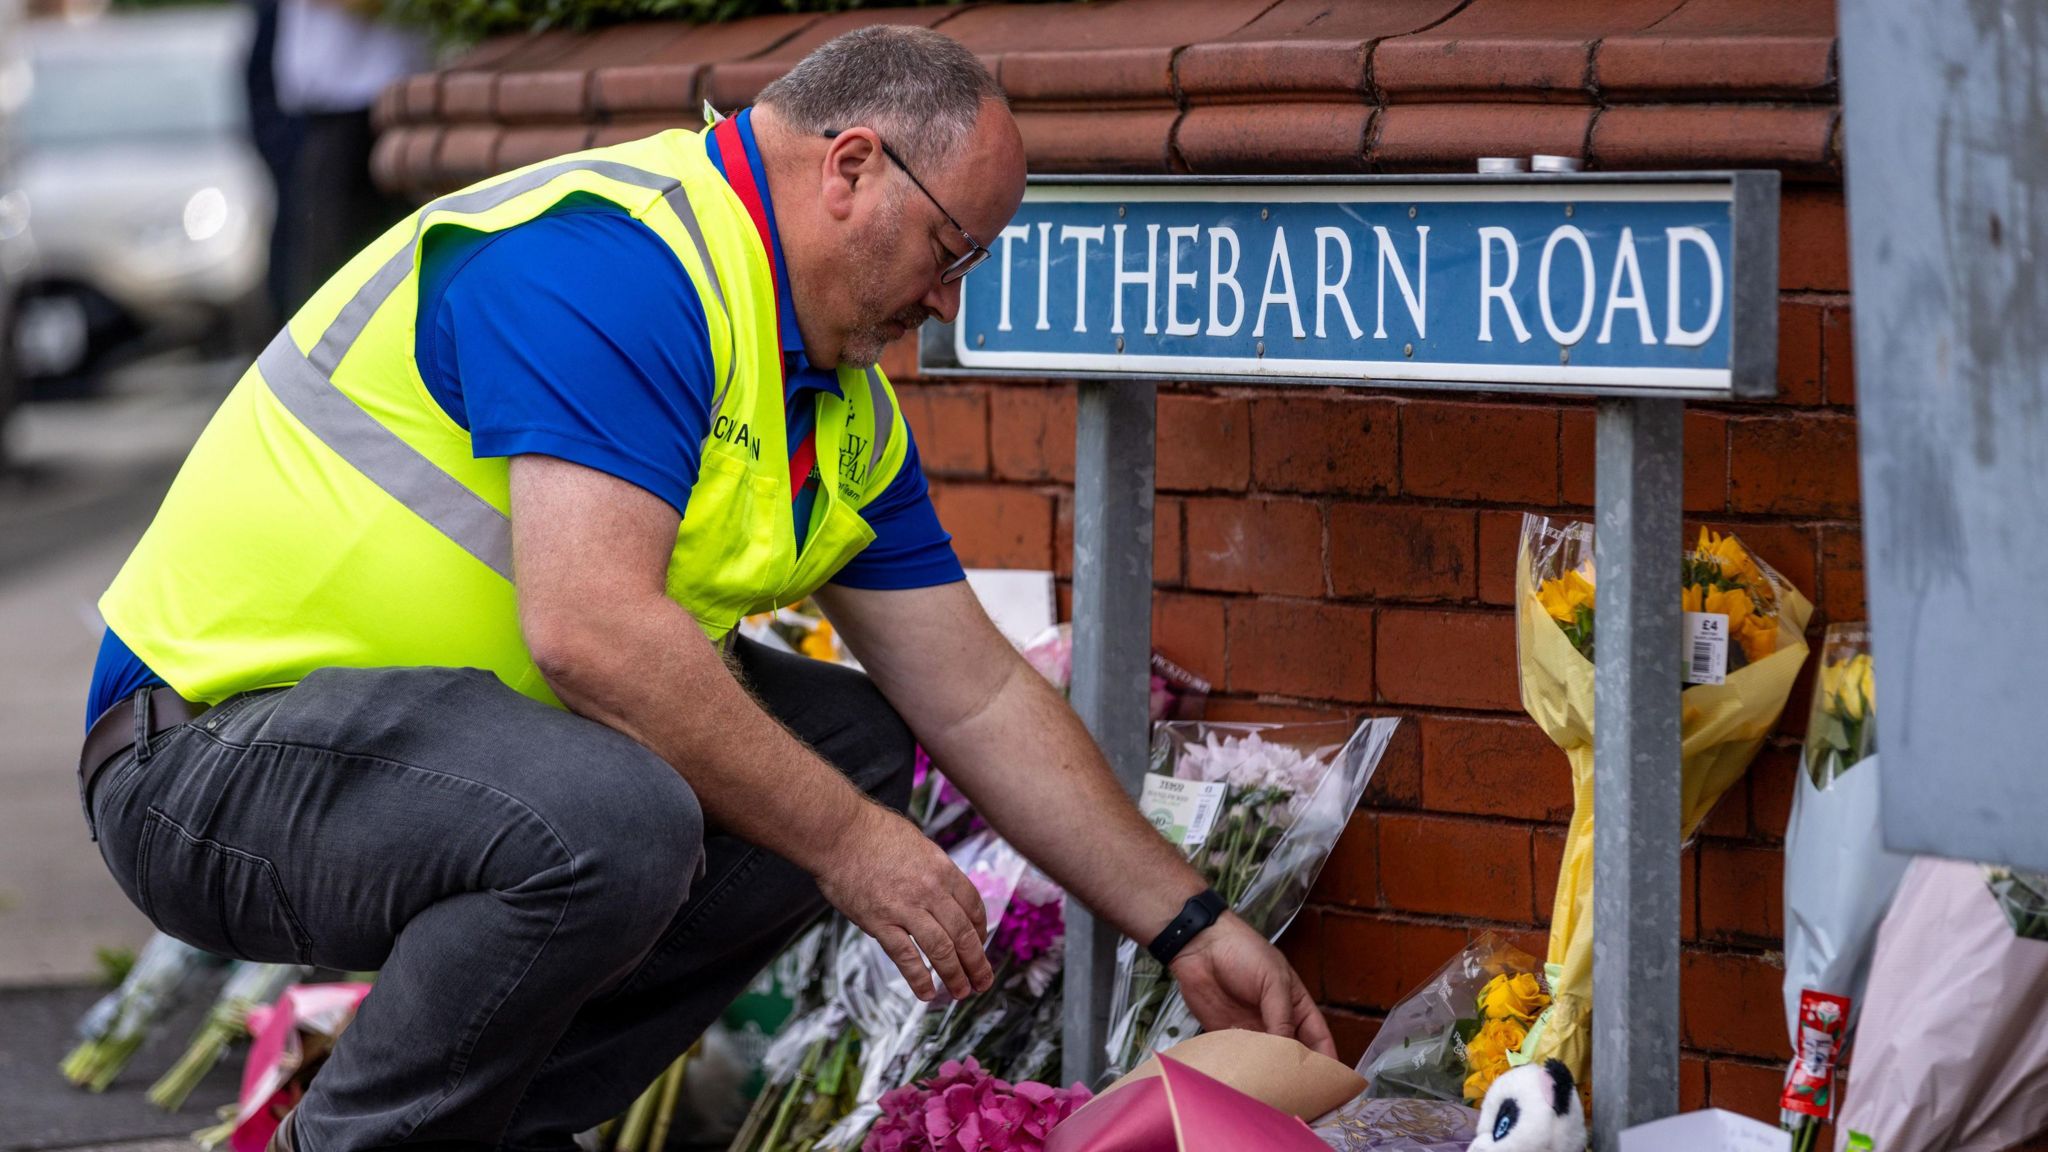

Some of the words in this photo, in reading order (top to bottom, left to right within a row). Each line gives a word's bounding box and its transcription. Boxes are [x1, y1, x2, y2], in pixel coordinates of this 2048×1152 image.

[997, 222, 1431, 340] TITHEBARN
[1478, 224, 1724, 346] ROAD
[1702, 620, 1718, 631] £4
